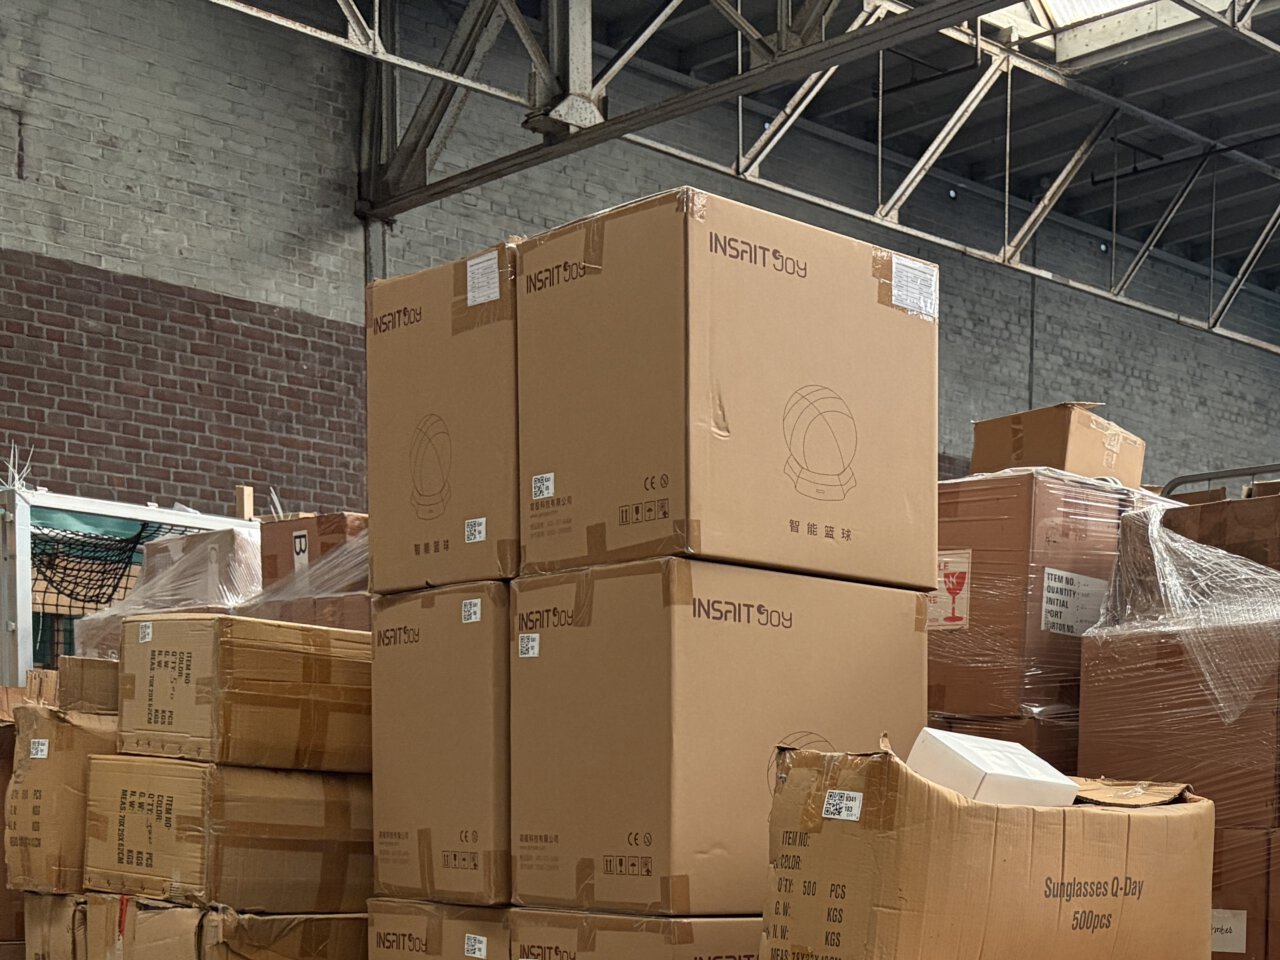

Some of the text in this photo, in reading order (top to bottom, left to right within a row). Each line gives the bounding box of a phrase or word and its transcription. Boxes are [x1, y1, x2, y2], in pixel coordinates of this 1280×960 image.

[788, 519, 852, 542] 智能篮球
[1047, 585, 1077, 598] QUANTITY
[165, 796, 174, 815] ITEM
[782, 831, 810, 848] ITEM NO:
[781, 854, 802, 871] COLOR:
[803, 881, 817, 897] 500
[830, 883, 847, 900] PCS
[1044, 876, 1144, 903] Sunglasses Q-Day
[827, 907, 843, 924] KGS
[1071, 910, 1113, 933] 500pcs
[825, 931, 841, 948] KGS
[1211, 927, 1233, 936] mber
